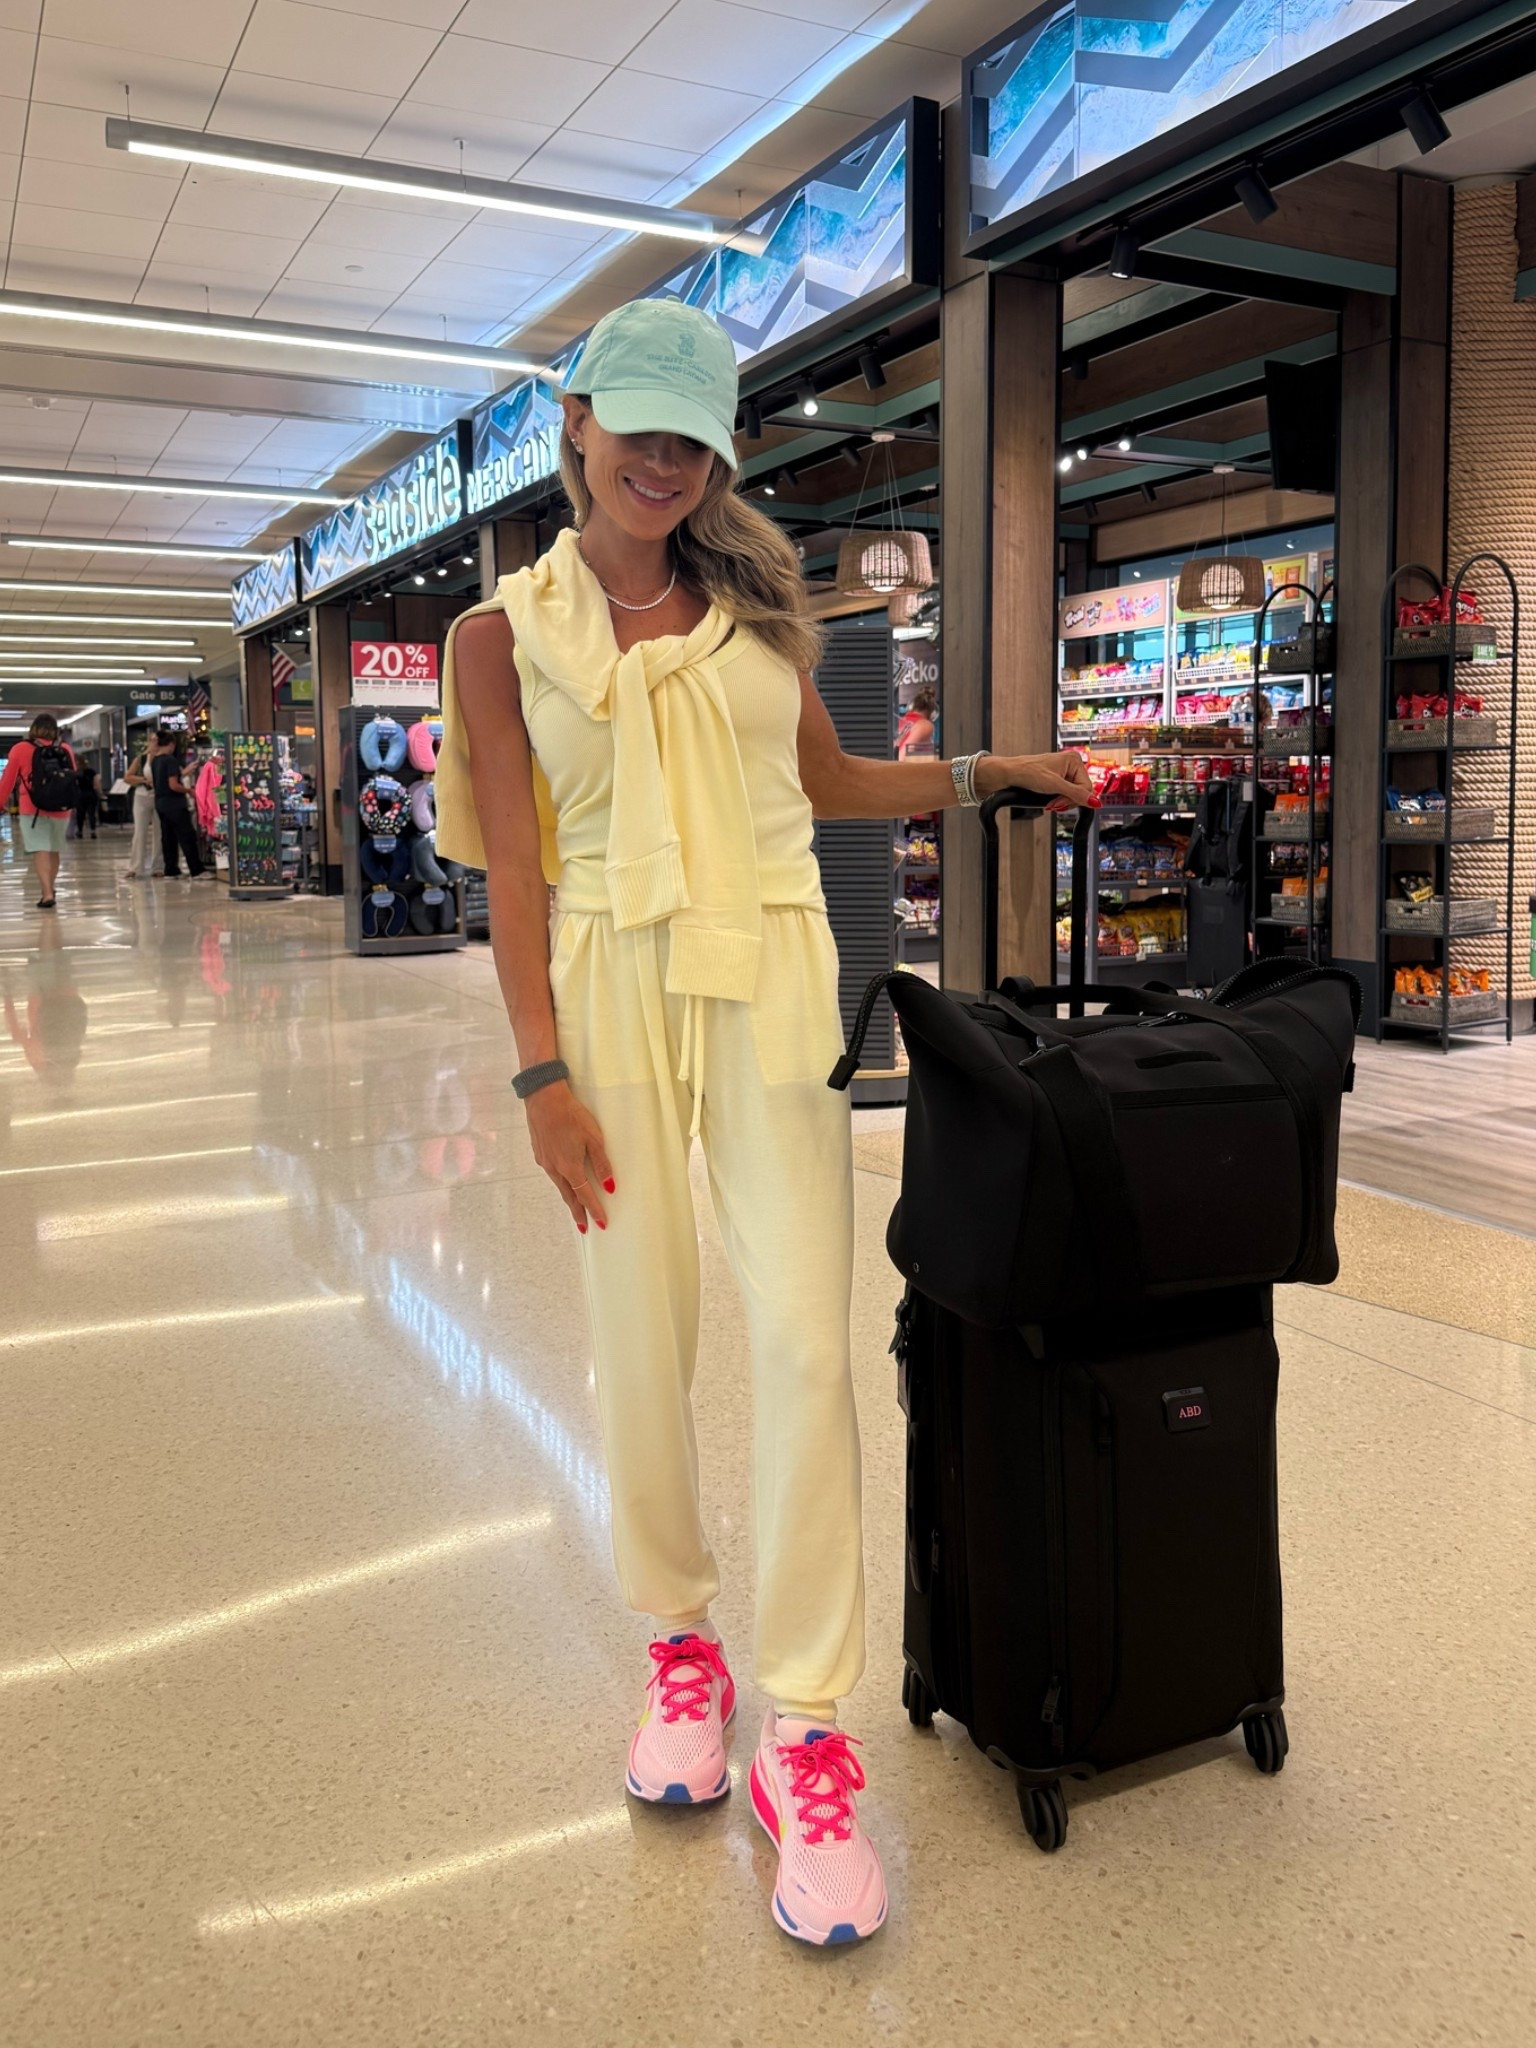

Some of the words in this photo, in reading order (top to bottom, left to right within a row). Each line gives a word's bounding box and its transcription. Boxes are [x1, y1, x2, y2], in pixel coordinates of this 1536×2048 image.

[365, 441, 463, 564] seaside
[466, 424, 560, 514] MERCAN
[360, 644, 428, 677] 20%
[404, 666, 430, 678] OFF
[129, 689, 156, 701] Gate
[159, 690, 176, 701] B5
[1178, 1405, 1202, 1419] ABD
